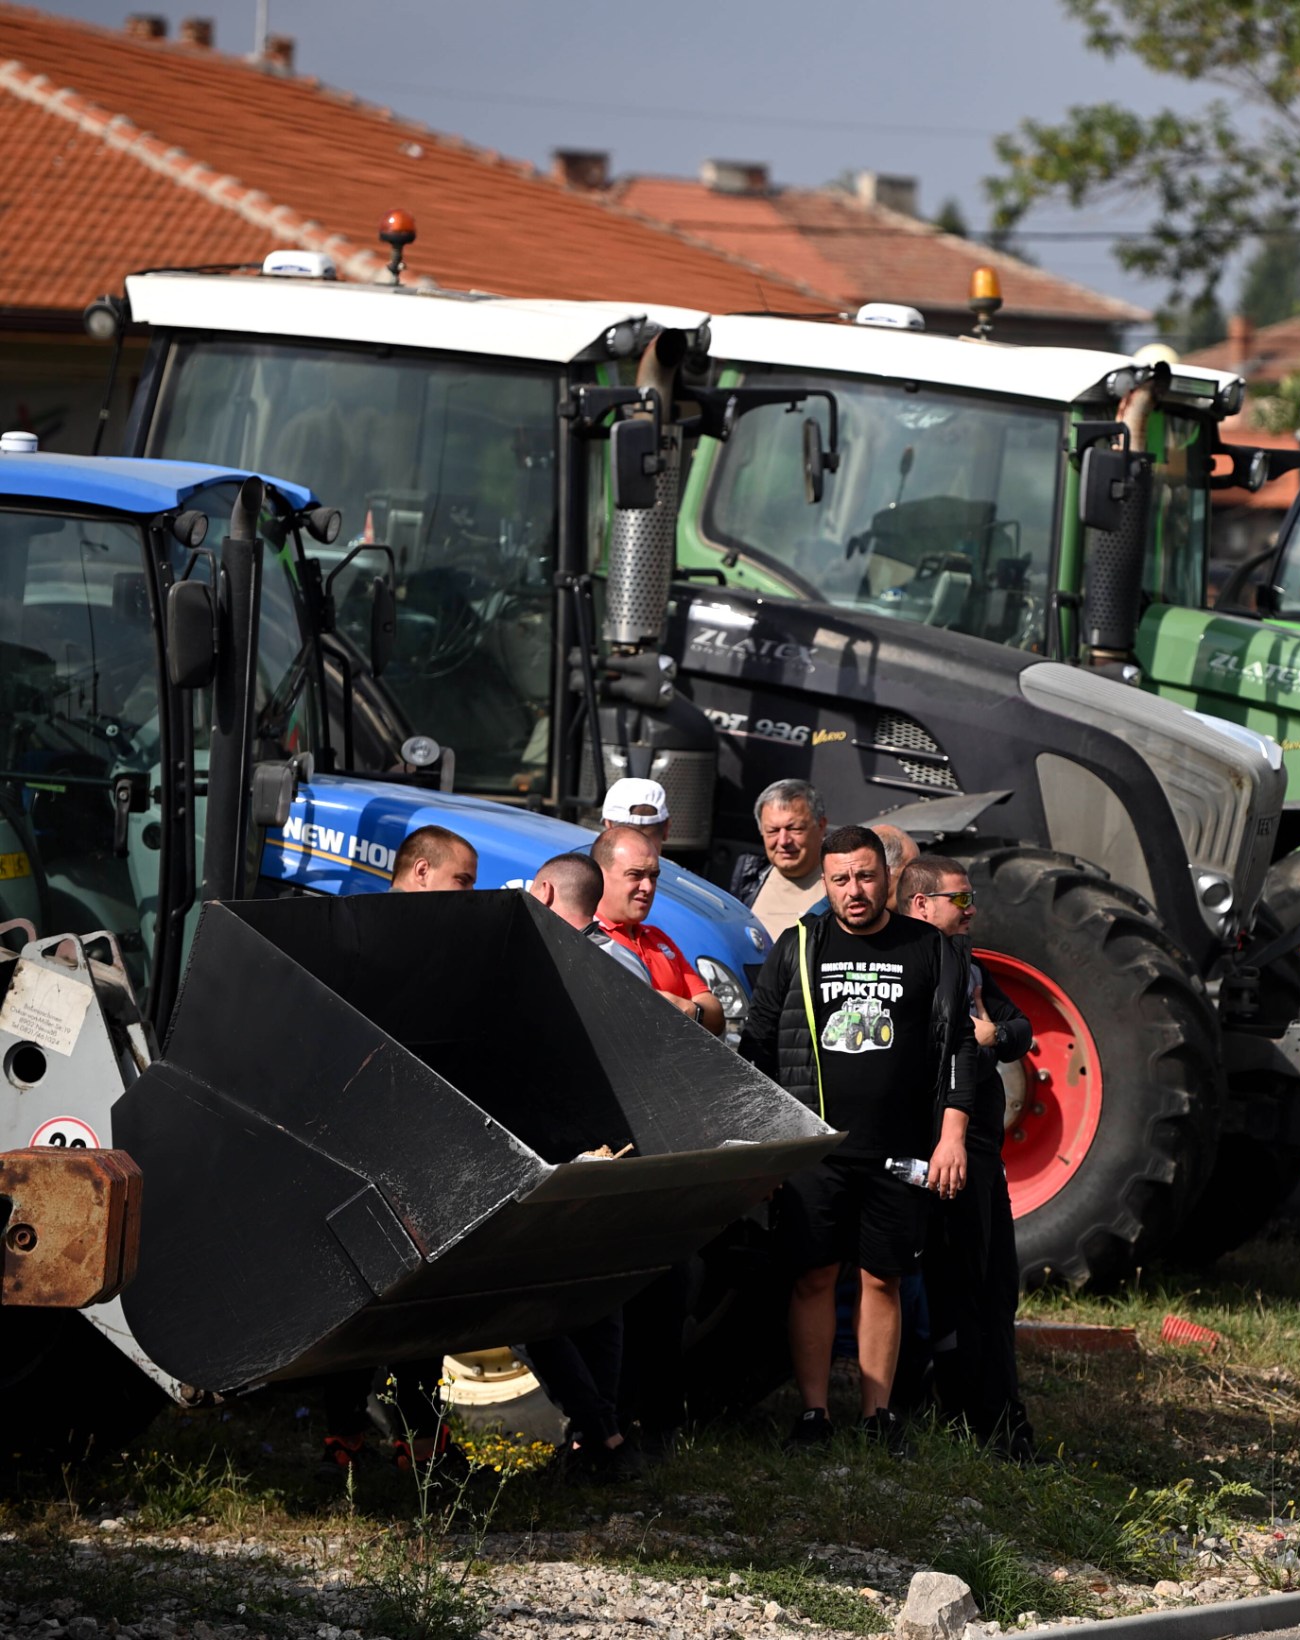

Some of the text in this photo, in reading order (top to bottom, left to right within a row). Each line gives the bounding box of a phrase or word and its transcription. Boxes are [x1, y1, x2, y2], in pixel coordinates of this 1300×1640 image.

[693, 627, 818, 664] ZLATEX
[755, 718, 811, 743] 936
[283, 816, 344, 854] NEW
[821, 962, 854, 973] НИКОГА
[856, 962, 867, 972] НЕ
[820, 981, 904, 1004] ТРАКТОР
